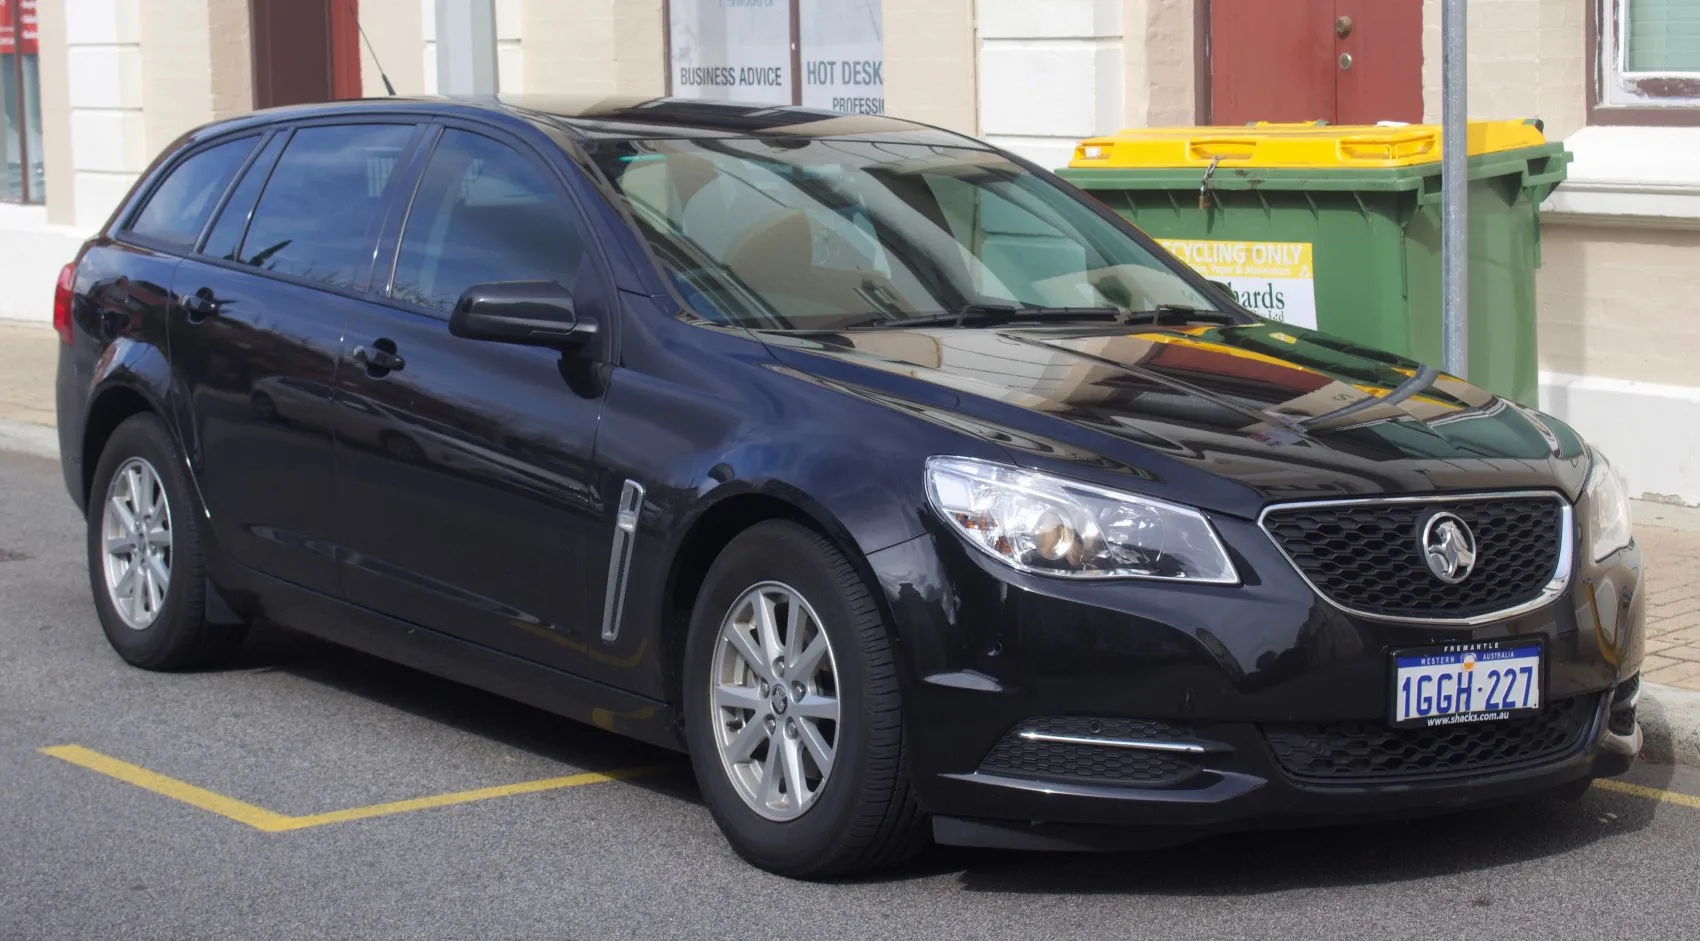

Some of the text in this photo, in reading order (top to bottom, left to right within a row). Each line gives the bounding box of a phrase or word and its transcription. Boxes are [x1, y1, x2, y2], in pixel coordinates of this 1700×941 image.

[680, 66, 782, 86] BUSINESS ADVICE
[806, 60, 836, 86] HOT
[1252, 243, 1303, 265] ONLY
[1444, 642, 1499, 653] FREMANTLE
[1421, 651, 1515, 666] WESTERN AUSTRALIA
[1427, 711, 1510, 727] www.shacks.com.au
